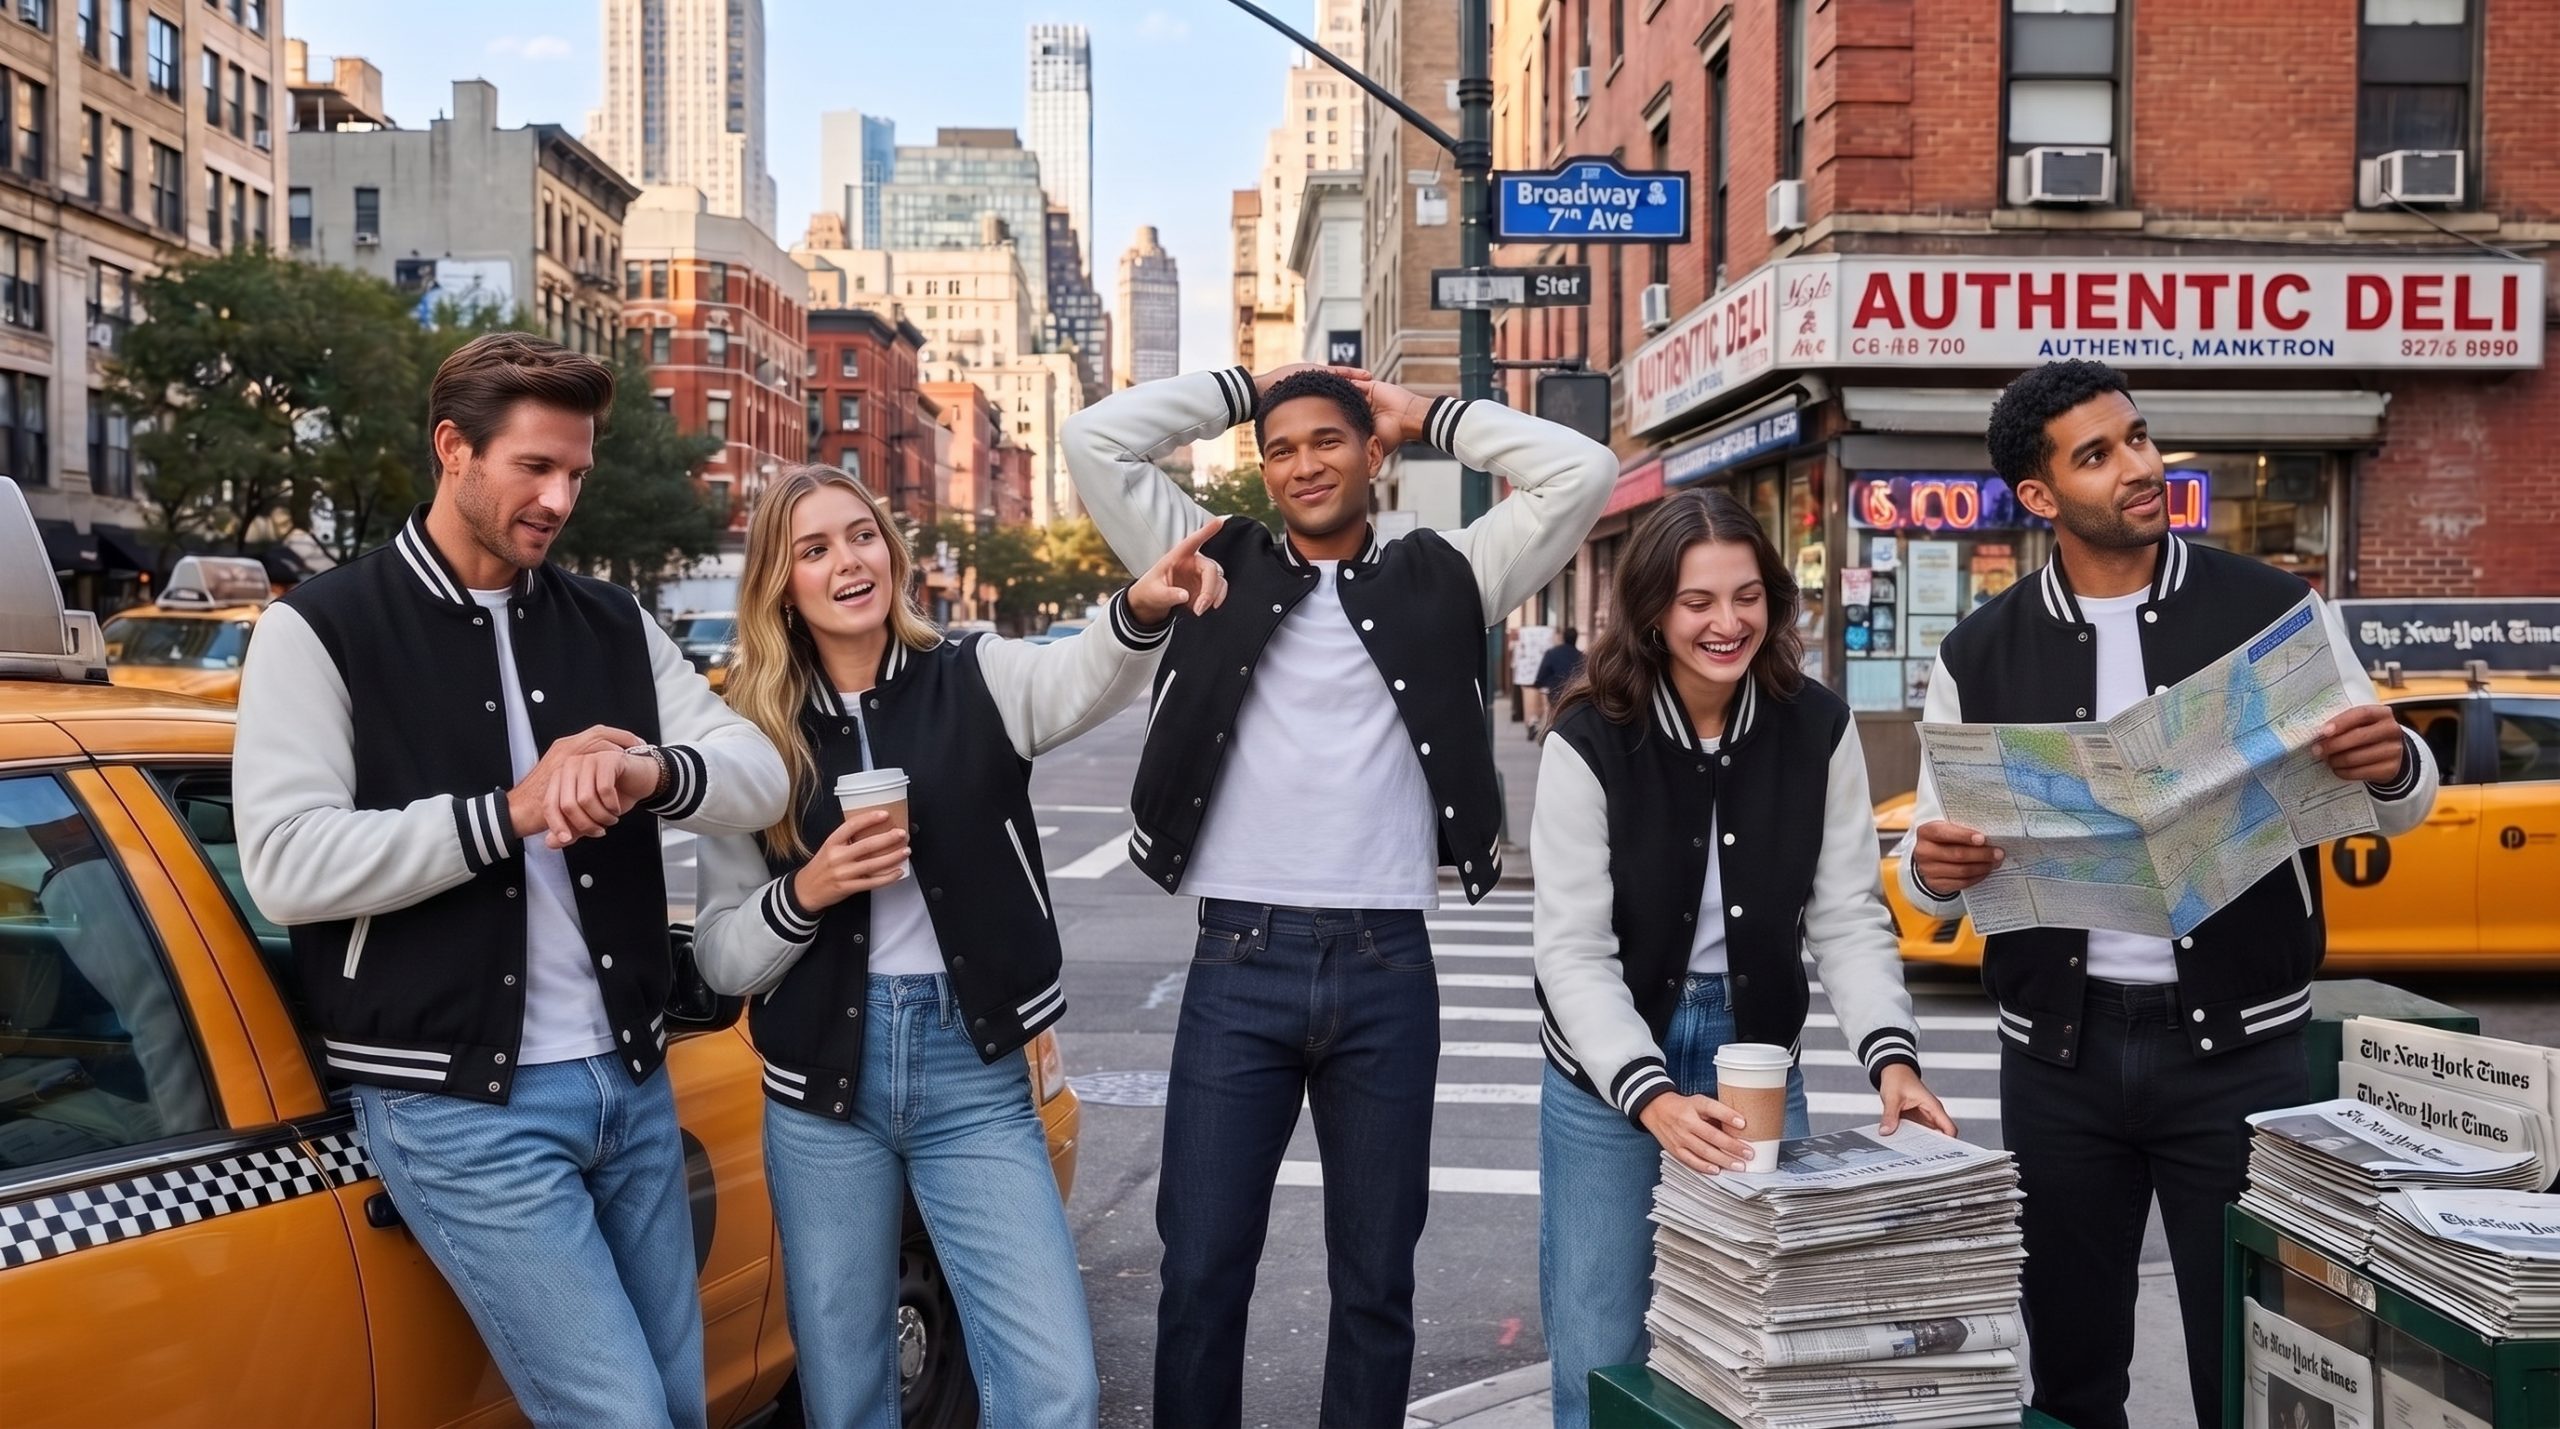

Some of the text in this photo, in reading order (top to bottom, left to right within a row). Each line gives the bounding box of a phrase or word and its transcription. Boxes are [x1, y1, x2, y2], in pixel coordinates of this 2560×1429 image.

[1518, 182, 1640, 210] Broadway
[1588, 208, 1633, 231] Ave
[1535, 275, 1580, 296] Ster
[1852, 272, 2310, 331] AUTHENTIC
[2346, 275, 2518, 331] DELI
[1726, 281, 1768, 356] DELI
[1928, 338, 1966, 355] 700
[2192, 339, 2335, 357] MANKTRON
[2360, 621, 2401, 650] The
[2452, 620, 2506, 650] York
[2360, 1038, 2530, 1089] The New York Times
[2357, 1083, 2509, 1142] The New York Times
